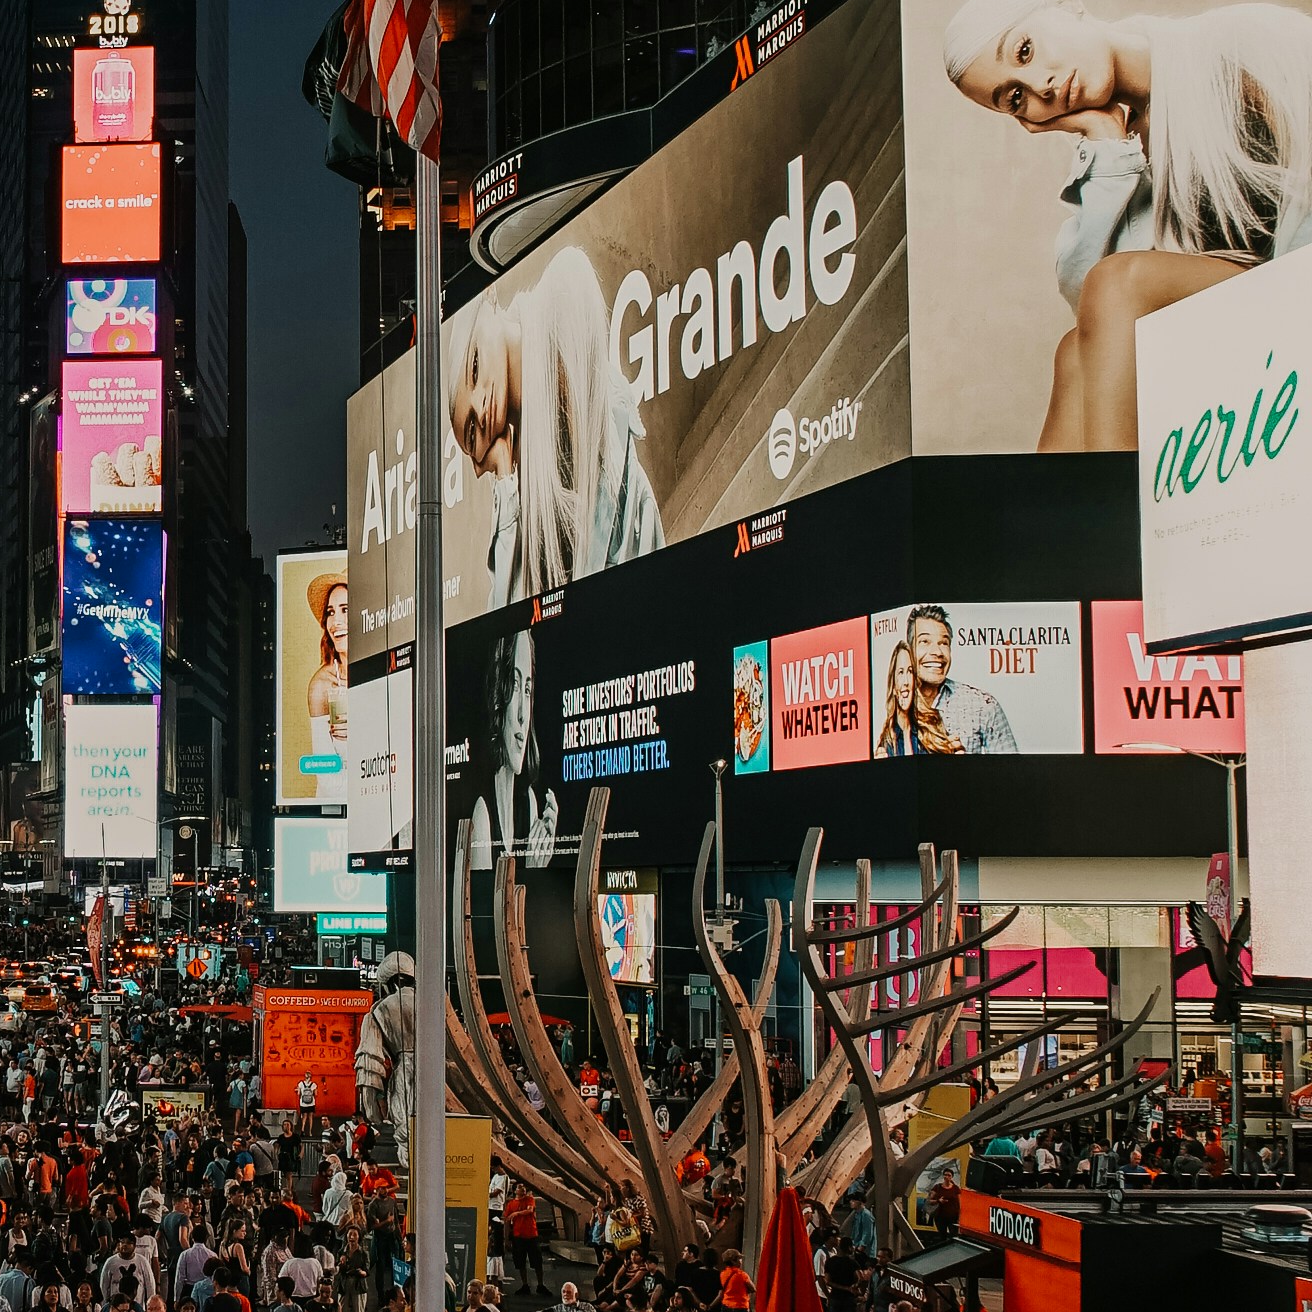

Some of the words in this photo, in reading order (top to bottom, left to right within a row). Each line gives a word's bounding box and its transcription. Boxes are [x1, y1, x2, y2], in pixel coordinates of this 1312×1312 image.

[88, 14, 139, 35] 2018
[757, 14, 804, 67] MARQUIS
[475, 151, 524, 197] MARRIOTT
[65, 194, 103, 209] crack
[104, 197, 115, 208] a
[475, 175, 518, 219] MARQUIS
[610, 154, 857, 403] Grande
[88, 377, 113, 389] GET
[67, 389, 106, 401] WHILE
[798, 396, 862, 458] Spotify
[1154, 349, 1299, 503] aerie
[751, 508, 787, 532] MARRIOTT
[751, 526, 783, 548] MARQUIS
[542, 589, 565, 606] MARRIOTT
[76, 602, 151, 621] #GetInTheMYX
[361, 606, 375, 634] The
[542, 602, 562, 620] MARQUIS
[874, 615, 898, 638] NETFLIX
[957, 626, 1007, 647] SANTA
[1009, 625, 1072, 646] CLARITA
[989, 646, 1038, 675] DIET
[561, 688, 584, 718] SOME
[636, 659, 695, 704] PORTFOLIOS
[781, 648, 855, 706] WATCH
[1123, 686, 1243, 720] WHAT
[561, 722, 578, 751] ARE
[578, 716, 608, 748] STUCK
[607, 714, 619, 741] IN
[618, 705, 660, 739] TRAFFIC.
[781, 698, 859, 740] WHATEVER
[73, 744, 110, 758] then
[111, 746, 148, 761] your
[561, 751, 594, 782] OTHERS
[595, 745, 631, 778] DEMAND
[632, 739, 671, 774] BETTER.
[90, 765, 131, 779] DNA
[80, 785, 142, 801] reports
[360, 784, 378, 796] SWISS
[606, 870, 638, 889] INVICTA
[269, 995, 316, 1006] COFFEED
[320, 997, 340, 1007] SWEET
[341, 997, 369, 1007] CHURROS
[903, 1279, 925, 1302] DOGS
